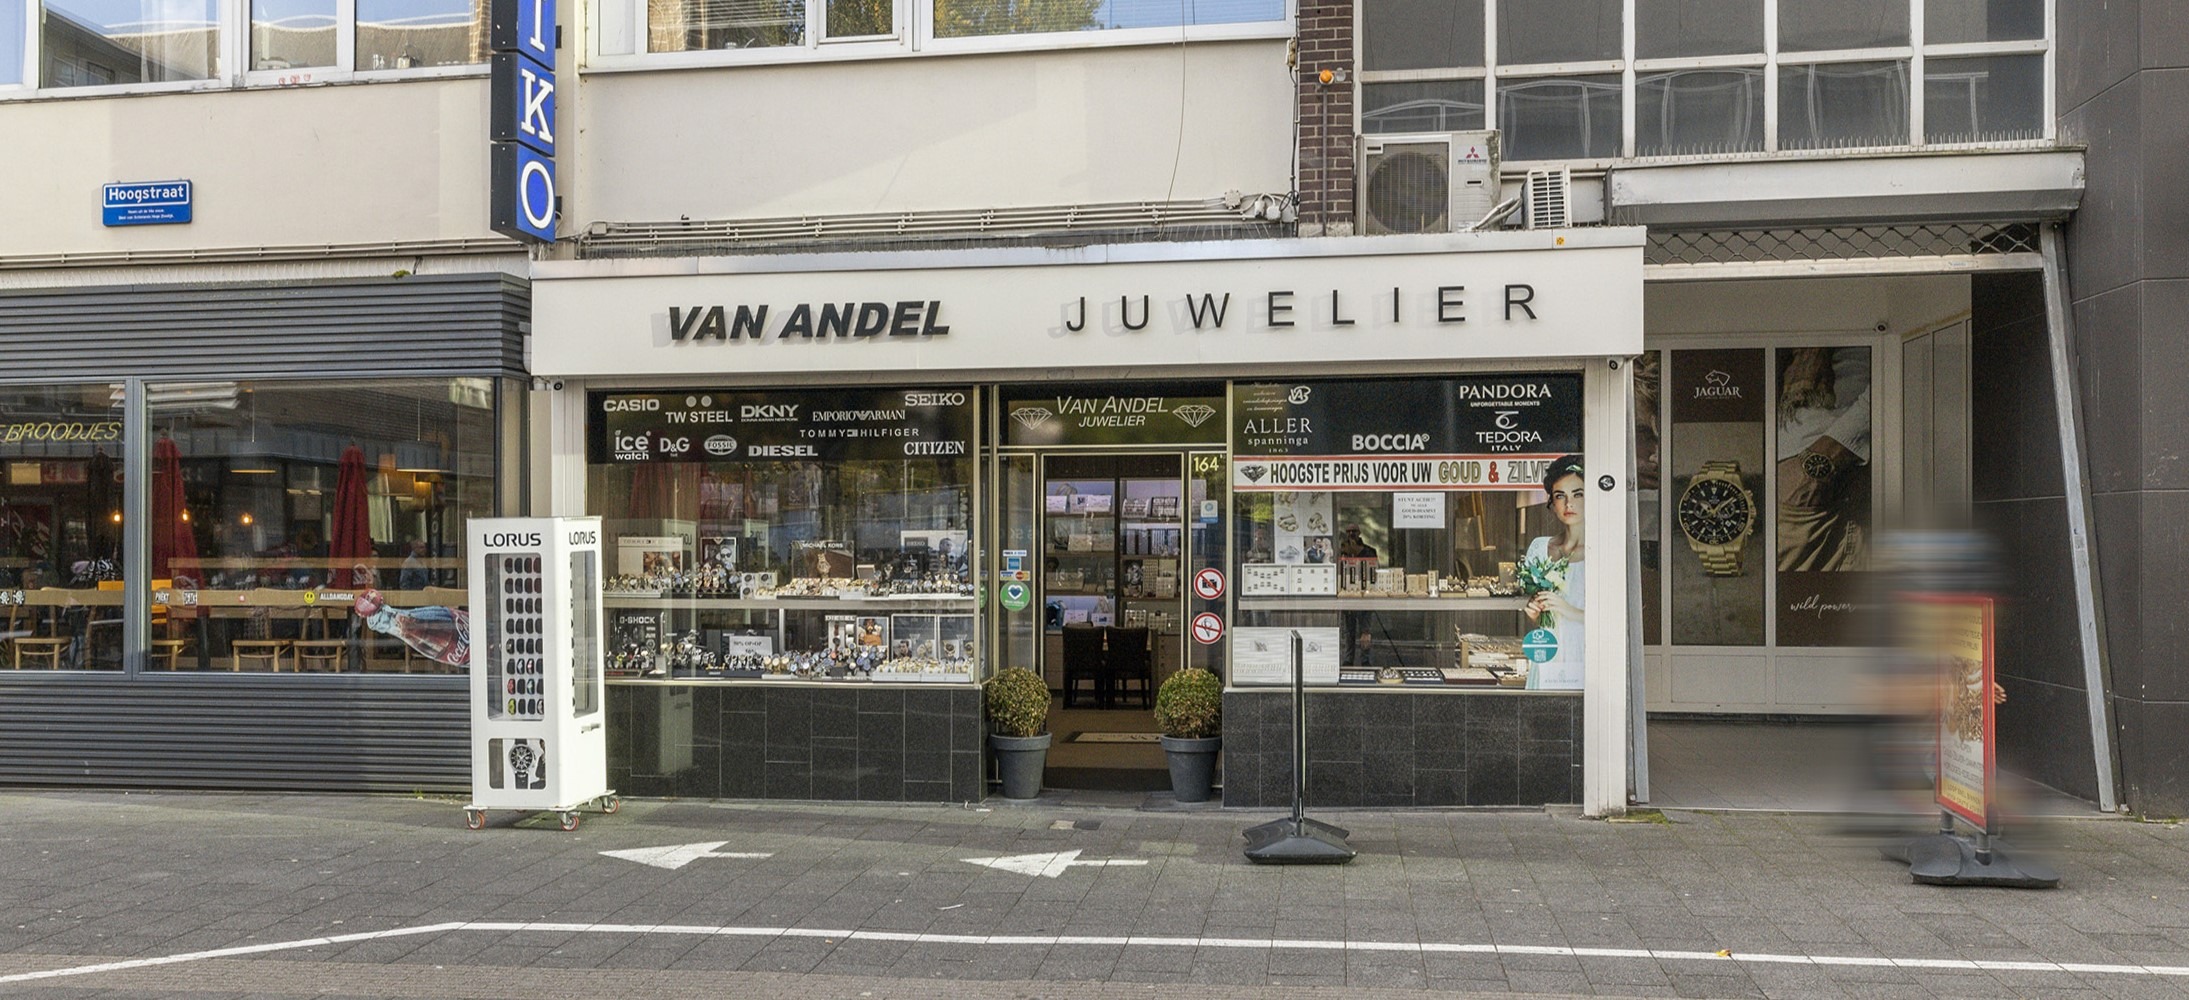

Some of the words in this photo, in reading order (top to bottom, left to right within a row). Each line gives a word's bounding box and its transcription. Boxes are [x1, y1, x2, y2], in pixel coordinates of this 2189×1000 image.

[109, 186, 184, 204] Hoogstraat
[1065, 283, 1538, 333] JUWELIER
[668, 304, 769, 341] VAN
[778, 300, 951, 339] ANDEL
[1459, 383, 1552, 400] PANDORA
[1693, 386, 1743, 399] JAGUAR
[603, 398, 660, 412] CASIO
[904, 392, 965, 407] SEIKO
[1056, 395, 1098, 415] VAN
[1101, 395, 1169, 414] ANDEL
[665, 411, 687, 423] TW
[689, 410, 733, 423] STEEL
[740, 403, 800, 418] DKNY
[812, 410, 857, 422] EMPORIO
[869, 409, 906, 421] ARMANI
[1078, 415, 1146, 428] JUWELIER
[1243, 417, 1313, 434] ALLER
[614, 430, 649, 450] ice
[799, 428, 846, 438] TOMMY
[860, 427, 920, 438] HILFIGER
[1475, 430, 1543, 444] TEDORA
[659, 437, 690, 453] D&G
[706, 440, 735, 450] FOSSIL
[903, 440, 966, 456] CITIZEN
[1247, 435, 1309, 448] spanninga
[1491, 444, 1522, 452] ITALY
[614, 452, 650, 461] watch
[748, 444, 819, 457] DIESEL
[1194, 455, 1220, 472] 164
[1270, 462, 1330, 484] HOOGSTE
[1333, 462, 1369, 484] PRIJS
[1373, 462, 1408, 484] VOOR
[1411, 461, 1432, 483] UW
[1438, 461, 1482, 484] GOUD
[1488, 461, 1500, 483] &
[483, 532, 542, 548] LORUS
[568, 530, 597, 546] LORUS
[1790, 593, 1820, 612] wild
